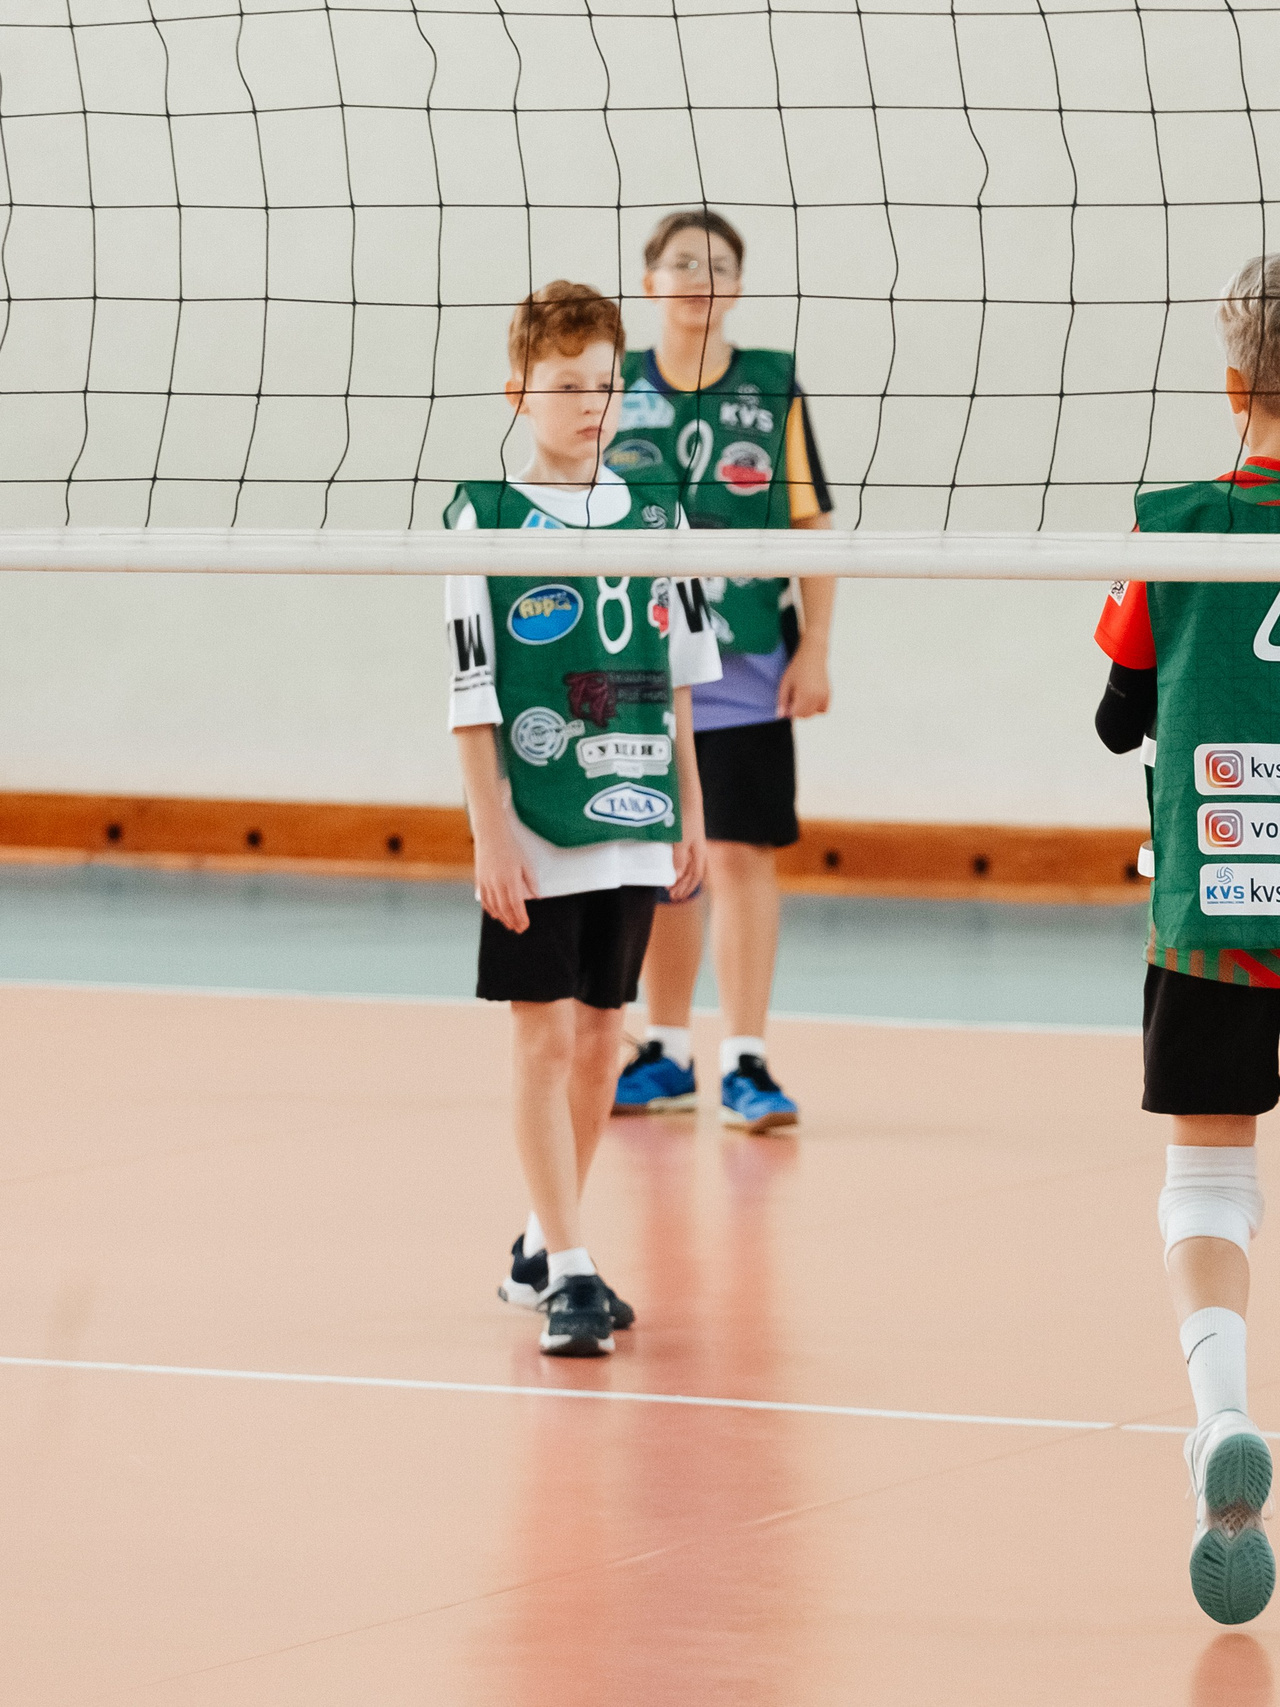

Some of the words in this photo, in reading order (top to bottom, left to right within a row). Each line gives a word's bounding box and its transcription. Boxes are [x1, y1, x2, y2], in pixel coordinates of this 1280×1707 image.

[719, 402, 774, 433] KVS
[676, 418, 714, 503] 9
[596, 577, 633, 655] 8
[1206, 886, 1245, 900] KVS
